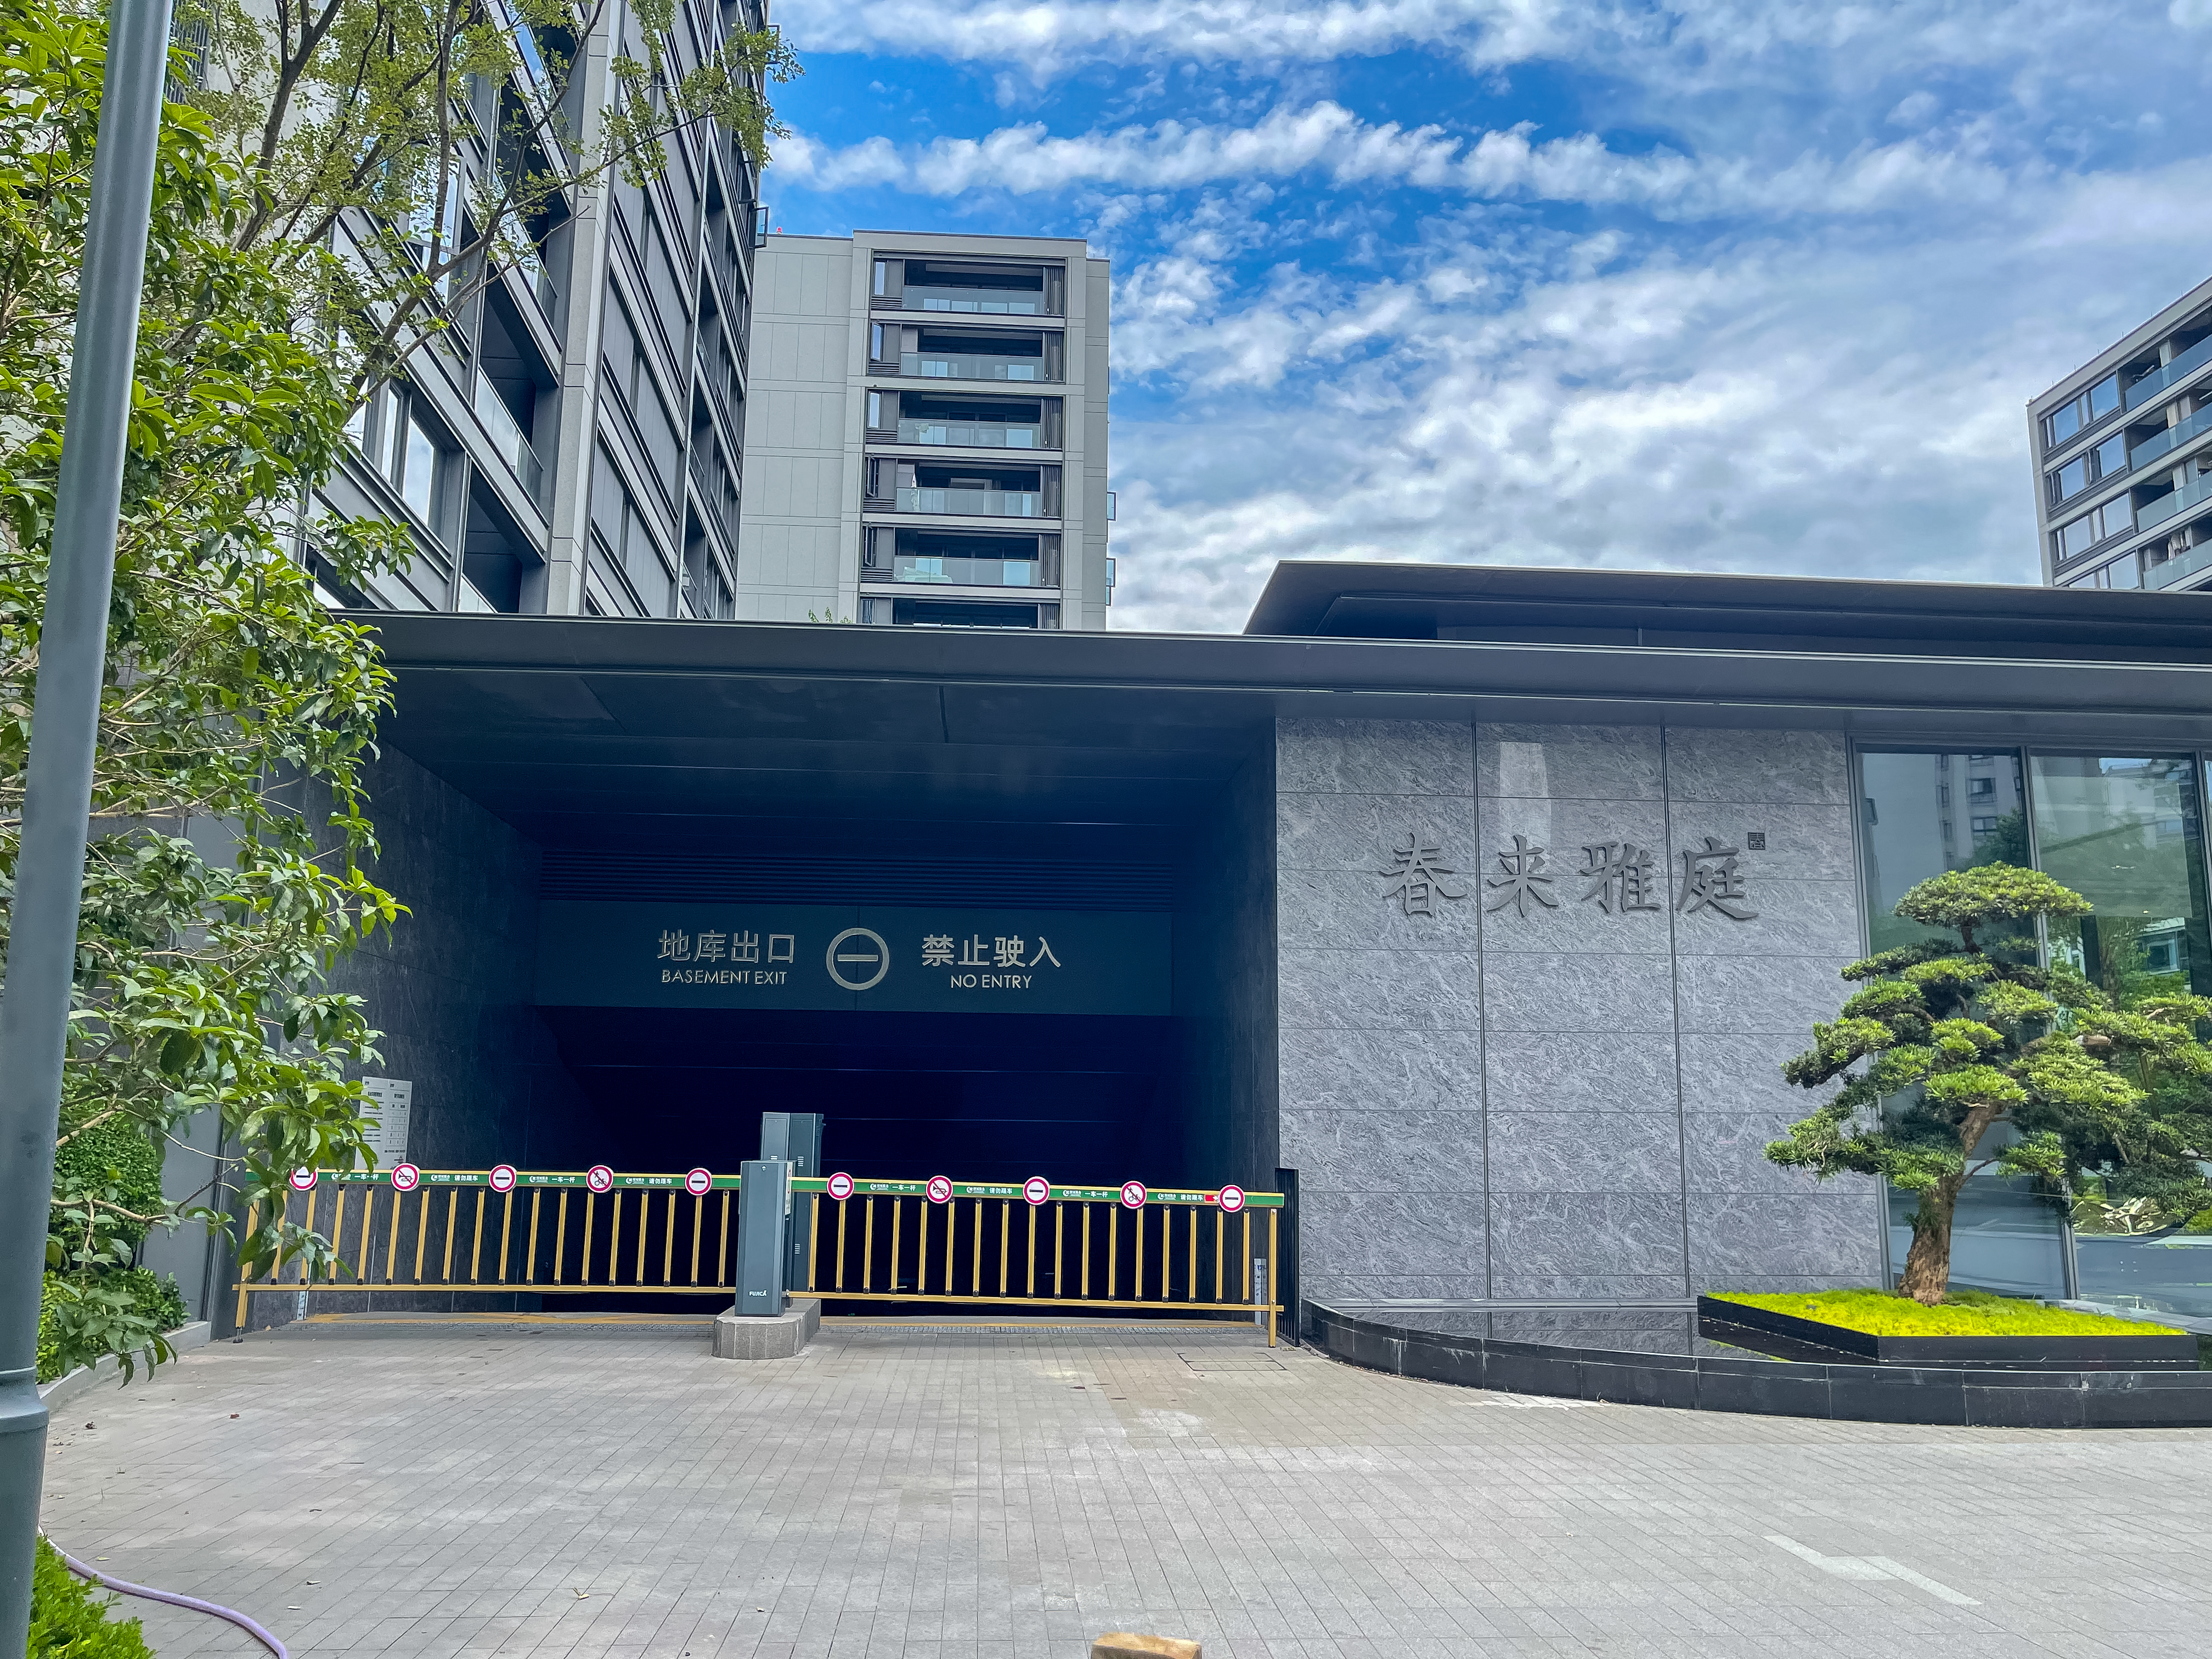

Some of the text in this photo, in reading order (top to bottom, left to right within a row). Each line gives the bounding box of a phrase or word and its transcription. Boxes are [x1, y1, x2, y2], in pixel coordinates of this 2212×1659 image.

[1378, 832, 1760, 921] 春来雅庭
[657, 929, 794, 963] 地库出口
[922, 934, 1061, 968] 禁止驶入
[661, 969, 787, 985] BASEMENT EXIT
[951, 974, 1032, 989] NO ENTRY
